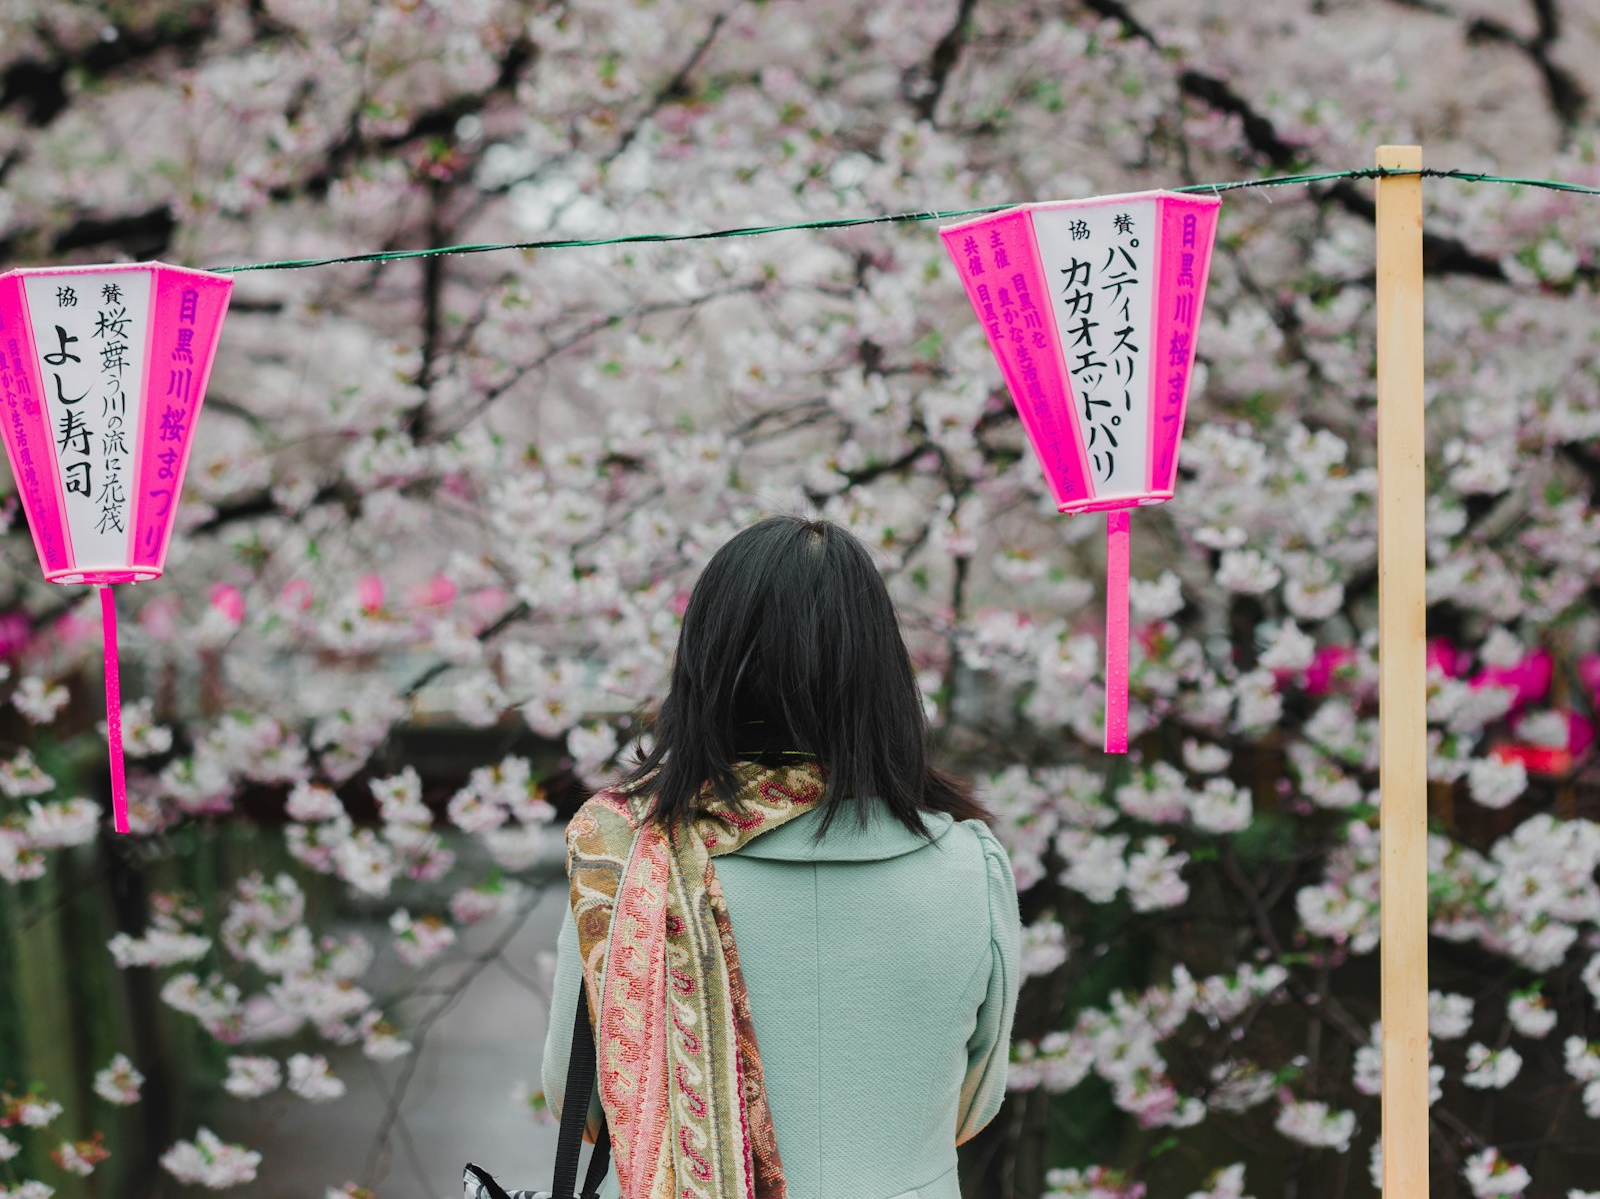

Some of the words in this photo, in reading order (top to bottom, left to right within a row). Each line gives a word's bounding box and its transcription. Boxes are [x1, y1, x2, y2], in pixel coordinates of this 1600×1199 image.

[963, 236, 986, 276] 共催
[976, 283, 1005, 340] 目黒区
[989, 229, 1011, 270] 主催
[1098, 238, 1140, 412] パティスリー
[1161, 213, 1198, 483] 目黒川桜まつり
[43, 324, 95, 498] よし寿司
[90, 307, 133, 535] 桜舞う川の流に花筏
[145, 289, 199, 558] 目黒川桜まつり
[1059, 256, 1122, 484] カカオエットパリ
